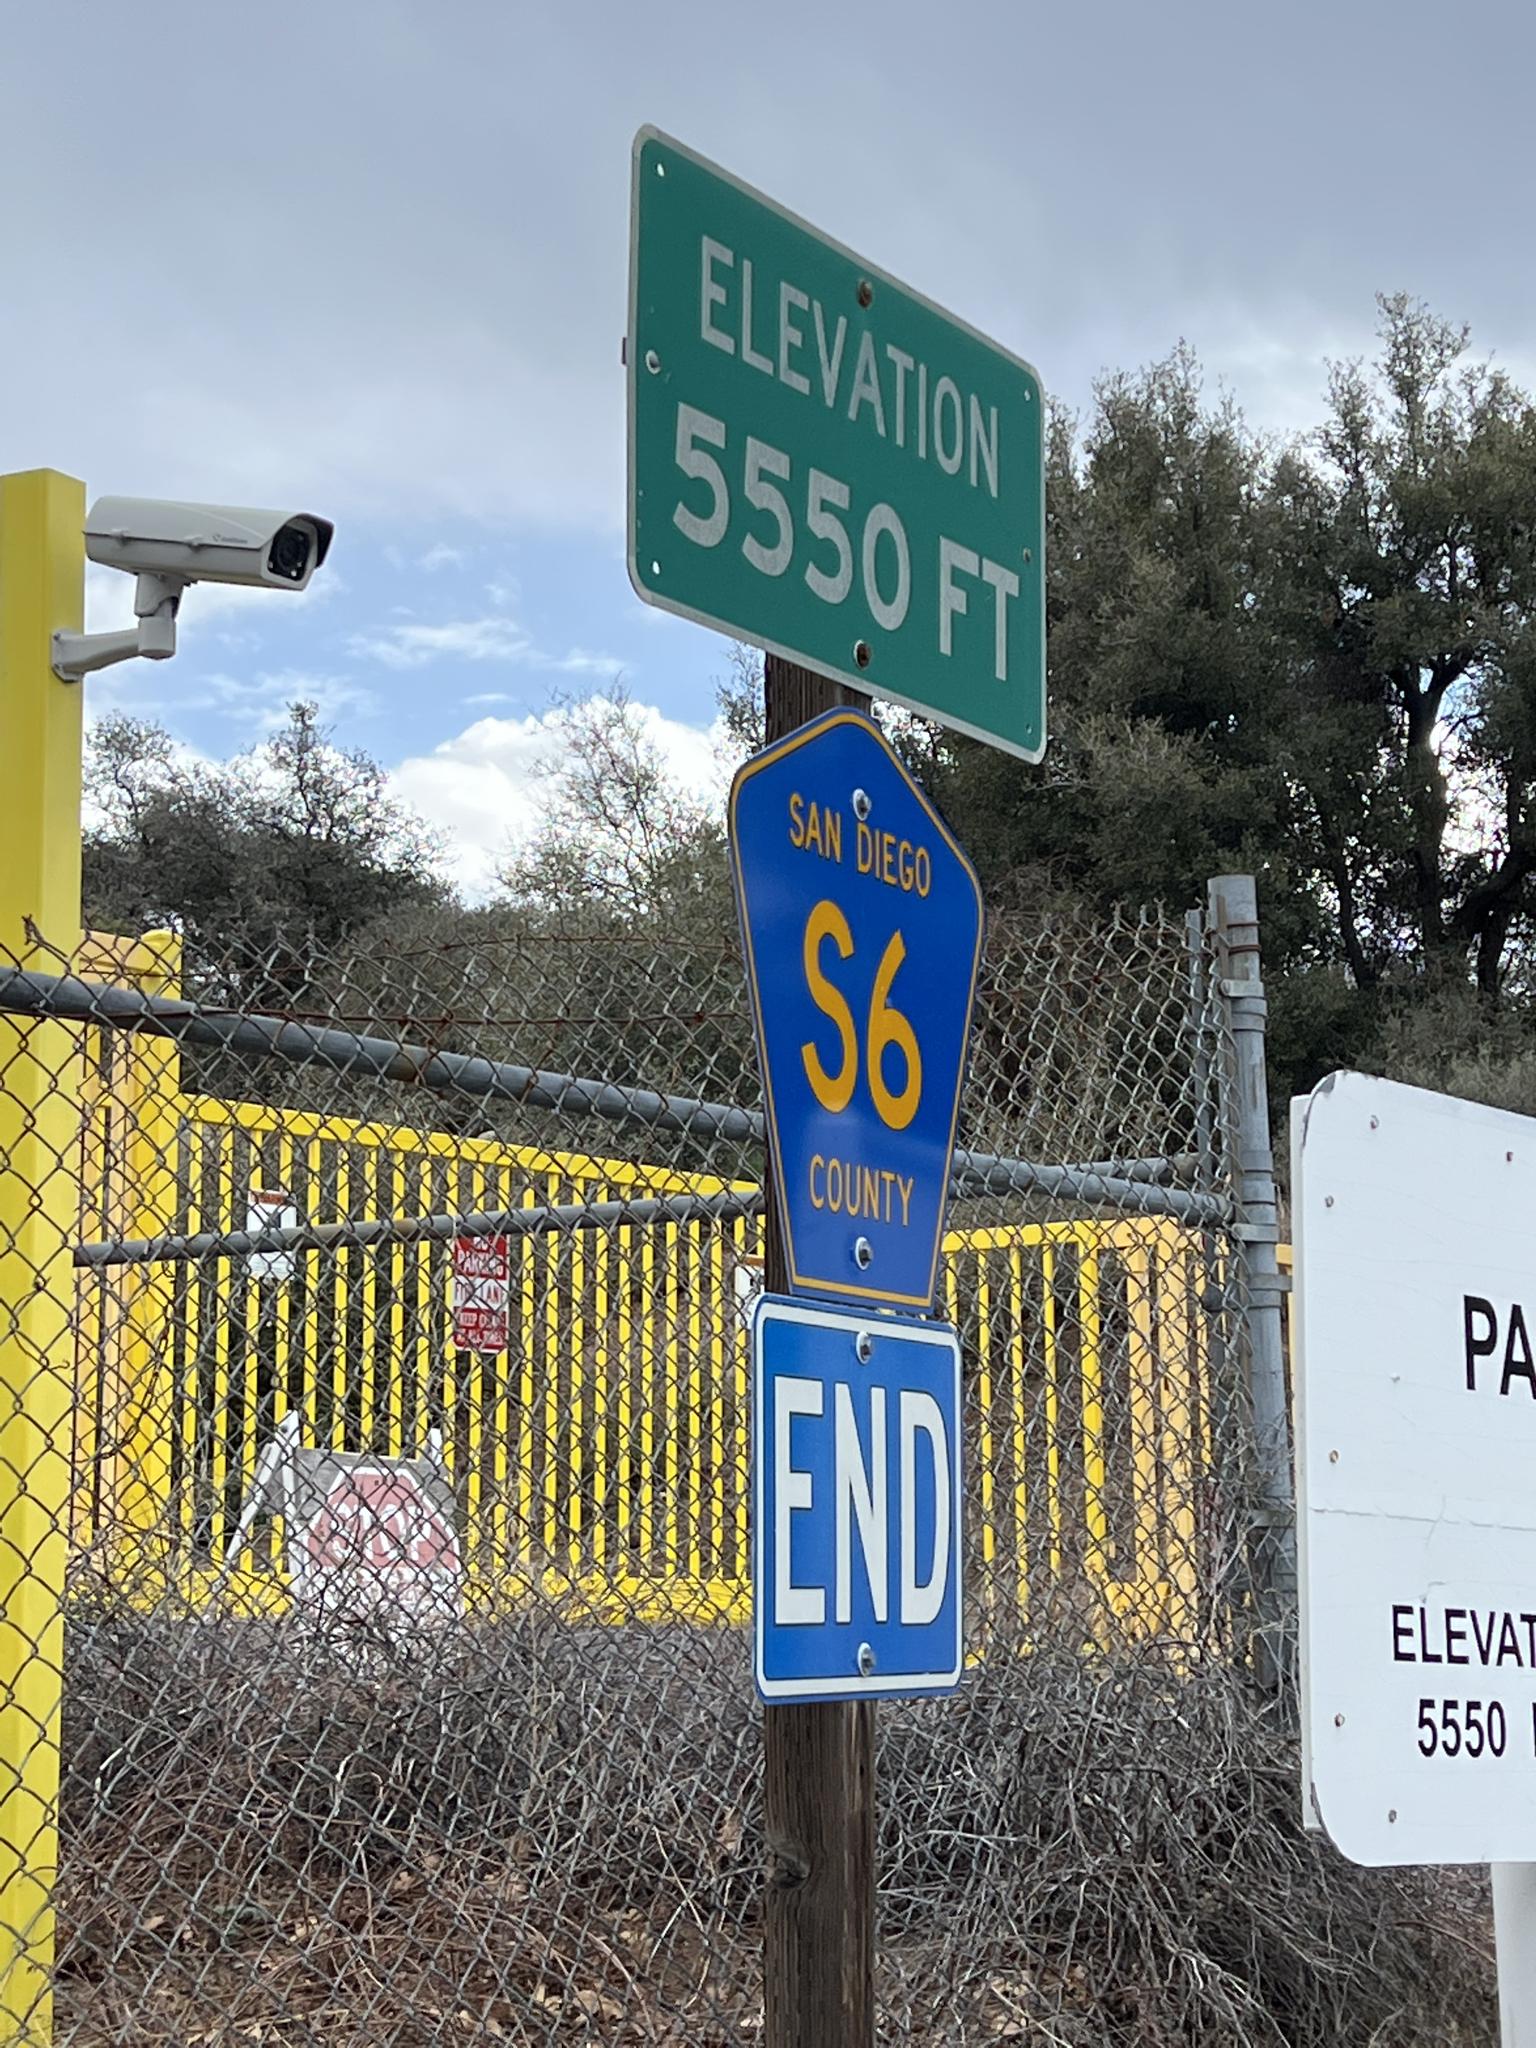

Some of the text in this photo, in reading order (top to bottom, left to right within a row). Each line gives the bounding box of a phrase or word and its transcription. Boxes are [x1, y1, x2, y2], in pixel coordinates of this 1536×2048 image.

[701, 234, 999, 499] ELEVATION
[672, 402, 1020, 682] 5550 FT
[789, 792, 931, 898] SAN DIEGO
[801, 899, 923, 1130] S6
[810, 1153, 914, 1227] COUNTY
[1463, 1294, 1536, 1401] PA
[774, 1375, 953, 1625] END
[1392, 1604, 1536, 1668] ELEVAT
[1417, 1698, 1507, 1758] 5550
